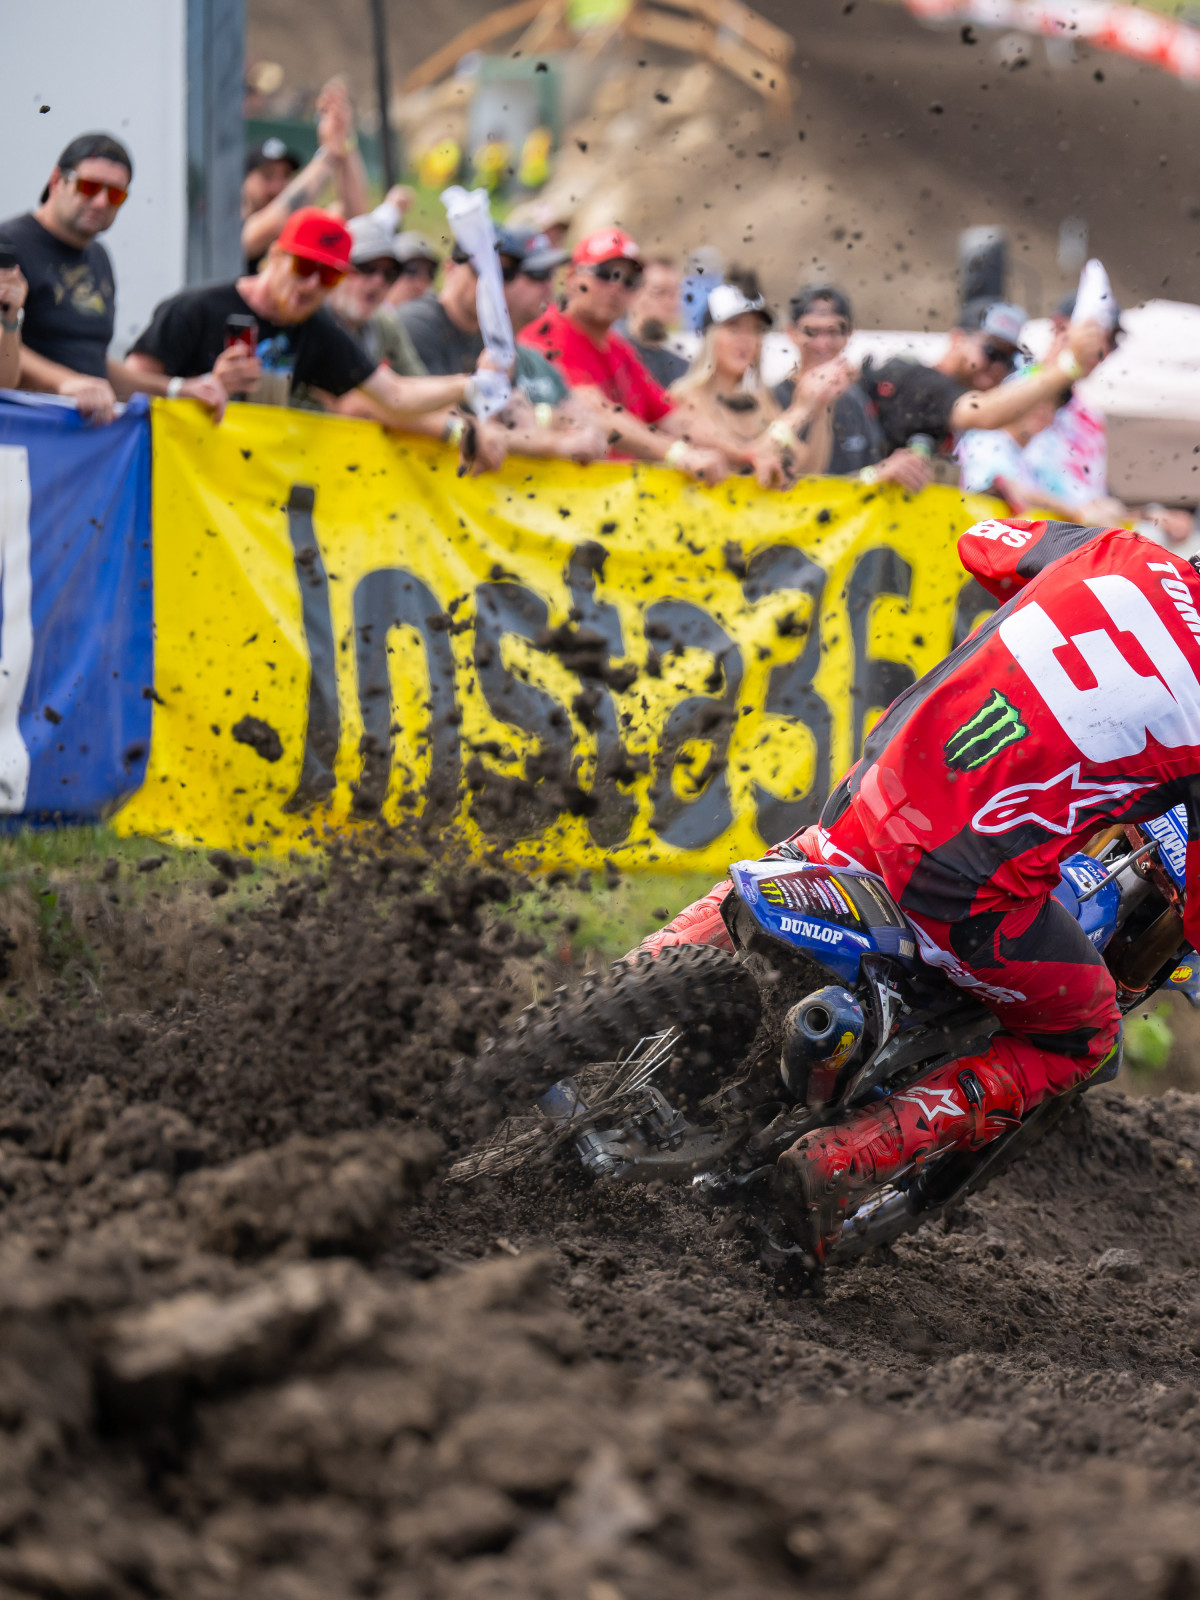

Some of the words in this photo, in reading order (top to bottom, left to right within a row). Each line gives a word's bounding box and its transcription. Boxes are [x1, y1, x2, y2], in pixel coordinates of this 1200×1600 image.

[1148, 817, 1186, 874] OTAPER
[774, 878, 794, 908] YAMAHA
[780, 916, 844, 945] DUNLOP
